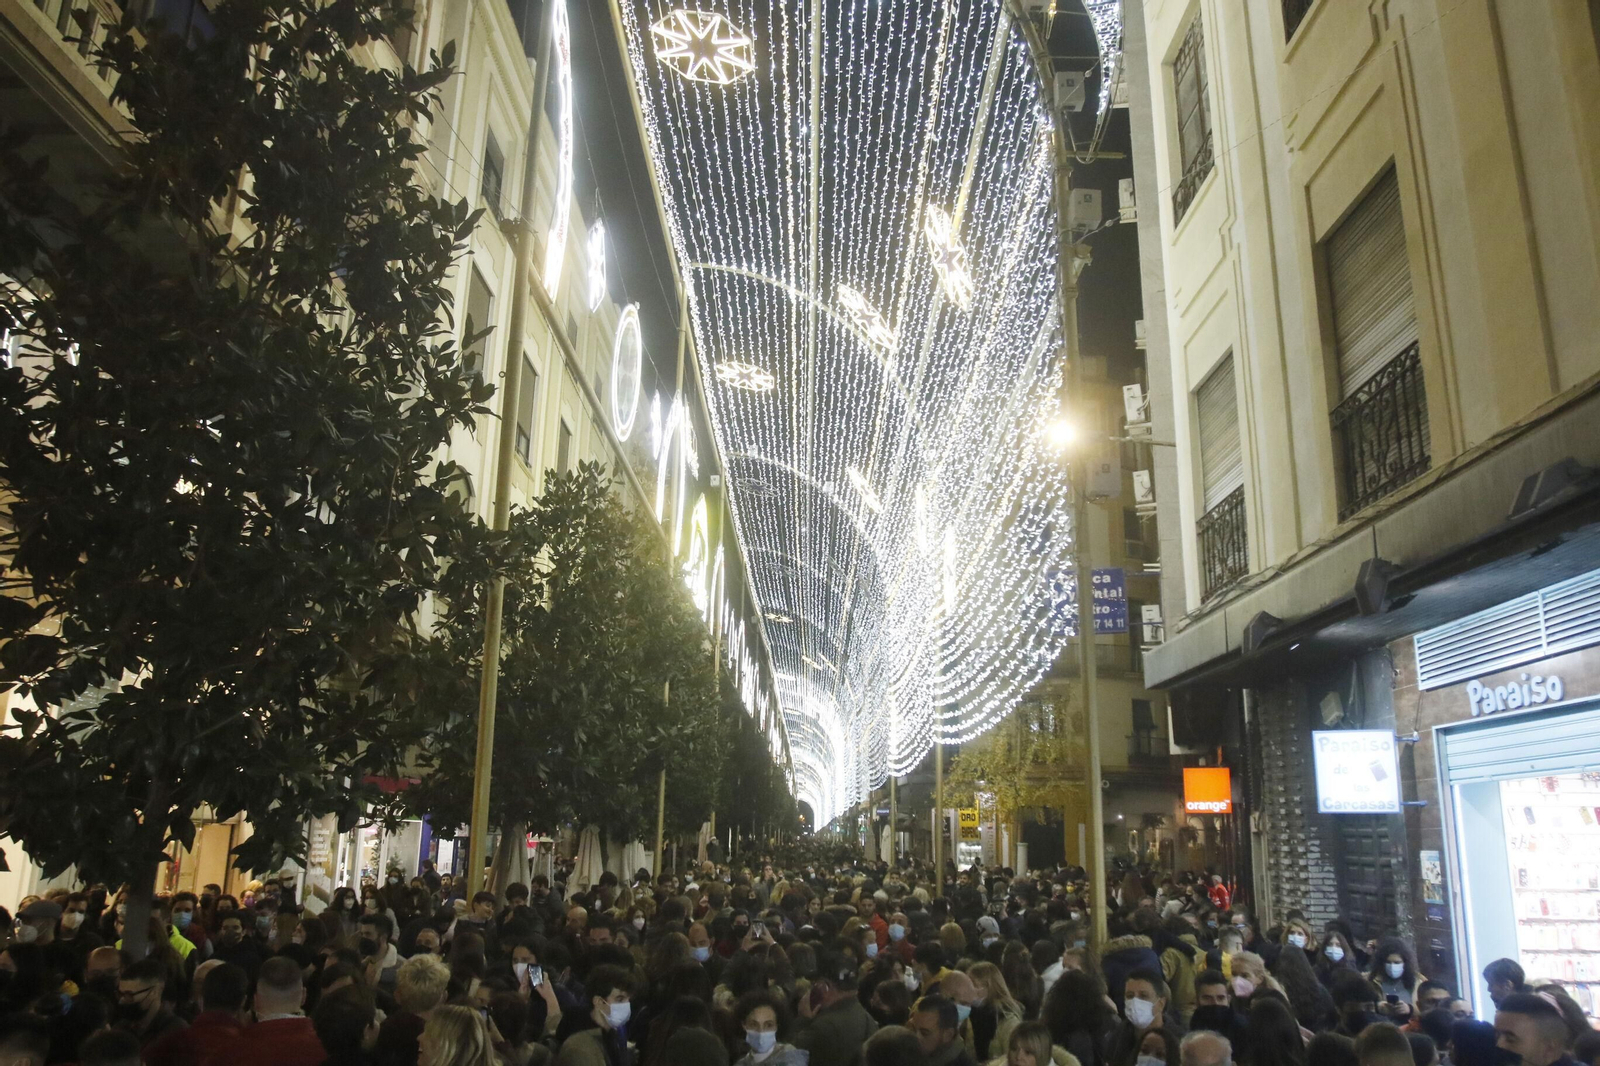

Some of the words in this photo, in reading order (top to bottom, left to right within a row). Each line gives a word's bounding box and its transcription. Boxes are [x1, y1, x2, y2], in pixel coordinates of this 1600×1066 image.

[1104, 619, 1113, 629] 14
[1466, 673, 1563, 716] Paraiso
[1318, 736, 1391, 752] Paraiso
[1333, 763, 1348, 775] de
[1353, 783, 1370, 793] las
[1186, 801, 1227, 812] orange
[1322, 796, 1396, 810] Carcasas
[961, 813, 976, 822] ORO
